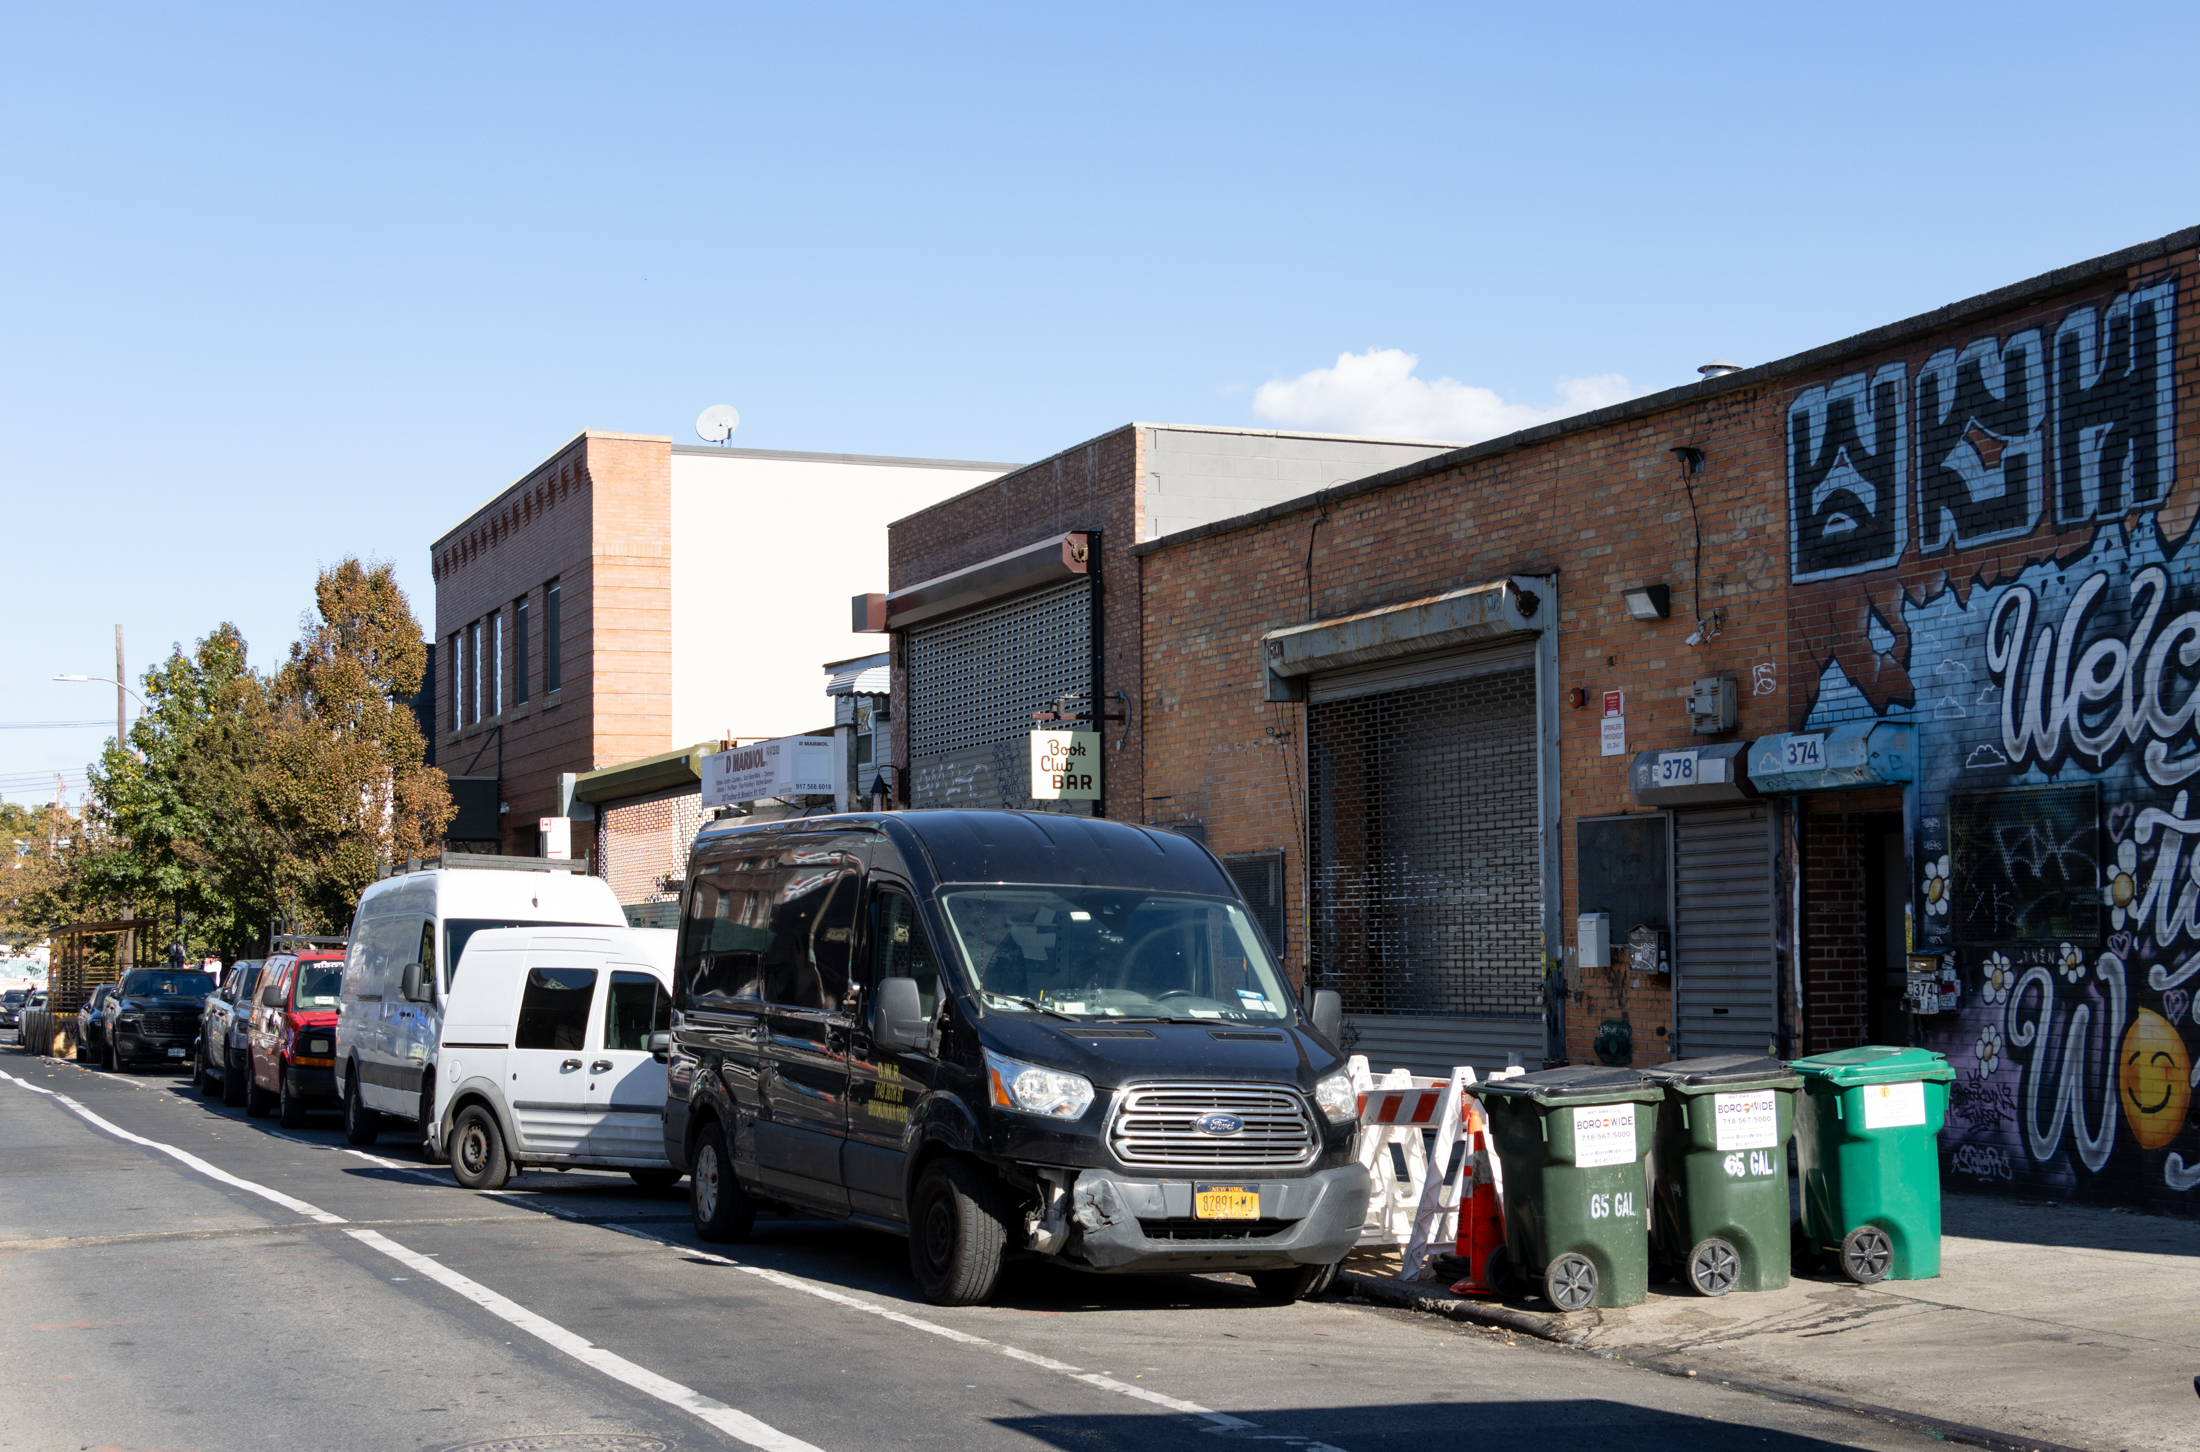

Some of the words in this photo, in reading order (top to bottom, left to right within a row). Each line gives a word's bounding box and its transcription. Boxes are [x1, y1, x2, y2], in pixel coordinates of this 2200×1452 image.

[1046, 739, 1086, 756] Book
[1787, 740, 1820, 765] 374
[726, 755, 732, 774] D
[733, 748, 766, 772] MARMOL
[1040, 755, 1074, 772] Club
[1662, 758, 1693, 780] 378
[1052, 774, 1092, 790] BAR
[1914, 984, 1932, 997] 374
[1880, 1088, 1888, 1098] T
[1718, 1104, 1742, 1114] BORO
[1751, 1101, 1774, 1111] WIDE
[1210, 1118, 1235, 1130] Ford
[1576, 1119, 1602, 1130] BORO
[1610, 1116, 1634, 1126] WIDE
[1722, 1116, 1772, 1124] 718-567-5000
[1582, 1130, 1630, 1141] 718-567-5000
[1724, 1152, 1746, 1178] 65
[1750, 1150, 1774, 1176] GAL
[1202, 1194, 1233, 1212] 82891
[1240, 1195, 1254, 1212] MJ
[1591, 1194, 1610, 1219] 65
[1614, 1192, 1636, 1218] GAL
